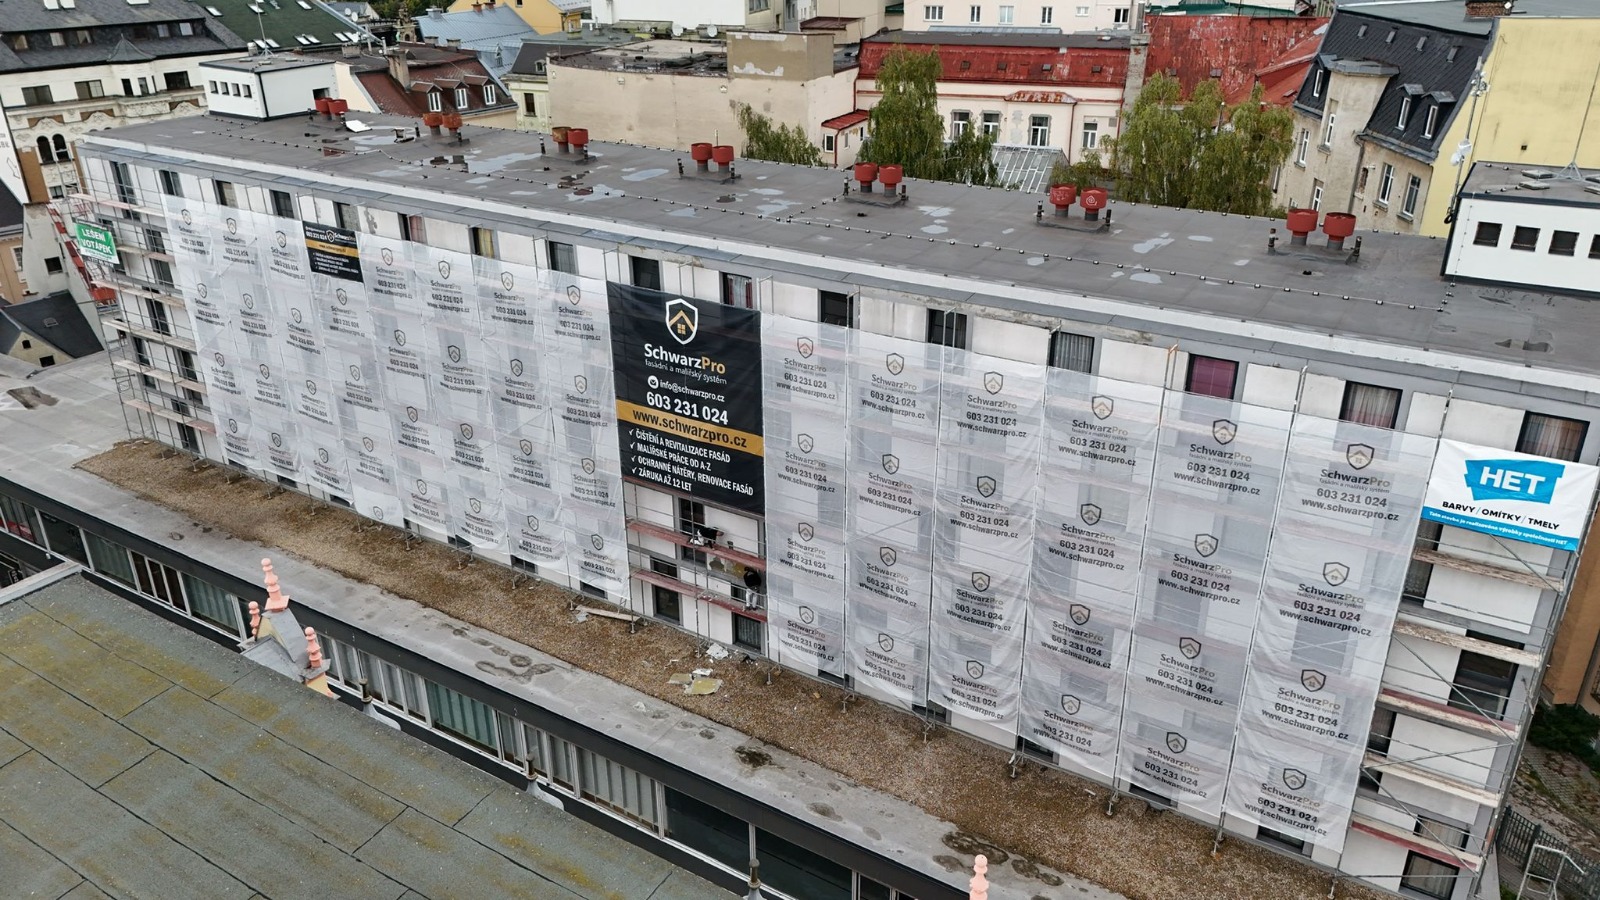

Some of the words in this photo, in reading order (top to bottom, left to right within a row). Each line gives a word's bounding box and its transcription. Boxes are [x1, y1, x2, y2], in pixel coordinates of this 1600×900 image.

[644, 343, 725, 374] SchwarzPro
[784, 358, 826, 372] SchwarzPro
[645, 359, 668, 372] fasádní
[675, 367, 702, 380] malířský
[703, 374, 727, 384] systém
[784, 373, 797, 382] 603
[798, 376, 811, 385] 231
[813, 379, 826, 389] 024
[660, 379, 725, 402] info@schwarzpro.cz
[776, 382, 835, 399] www.schwarzpro.cz
[872, 374, 917, 390] SchwarzPro
[646, 391, 671, 410] 603
[674, 399, 699, 418] 231
[702, 405, 728, 425] 024
[871, 391, 884, 400] 603
[886, 394, 899, 403] 231
[901, 397, 916, 407] 024
[968, 395, 1017, 409] SchwarzPro
[862, 400, 925, 419] www.schwarzpro.cz
[967, 412, 981, 421] 603
[983, 414, 998, 423] 231
[1001, 417, 1016, 426] 024
[633, 410, 747, 448] www.schwarzpro.cz
[957, 421, 1026, 437] www.schwarzpro.cz
[1072, 420, 1128, 436] SchwarzPro
[636, 428, 659, 443] ČIŠTĚNÍ
[660, 437, 664, 446] A
[665, 438, 708, 458] REVITALIZACE
[709, 451, 731, 463] FASÁD
[1070, 437, 1087, 446] 603
[1089, 440, 1105, 450] 231
[1109, 443, 1126, 453] 024
[1190, 444, 1252, 462] SchwarzPro
[637, 442, 668, 459] MALÍŘSKÉ
[669, 452, 689, 466] PRÁCE
[690, 458, 699, 468] OD
[700, 460, 711, 472] A-Z
[1059, 445, 1136, 466] www.schwarzpro.cz
[638, 456, 671, 473] OCHRANNÉ
[698, 472, 731, 490] RENOVACE
[732, 483, 753, 496] FASÁD
[639, 467, 663, 482] ZÁRUKA
[664, 474, 672, 485] AŽ
[673, 478, 681, 488] 12
[682, 480, 692, 491] LET
[785, 466, 797, 475] 603
[799, 469, 811, 478] 231
[813, 472, 826, 482] 024
[869, 472, 912, 489] SchwarzPro
[1187, 462, 1205, 473] 603
[1208, 466, 1226, 477] 231
[1230, 469, 1250, 481] 024
[1320, 469, 1391, 488] SchwarzPro
[1479, 466, 1546, 495] HET
[1174, 472, 1260, 495] www.schwarzpro.cz
[859, 495, 921, 516] www.schwarzpro.cz
[868, 487, 880, 497] 603
[882, 491, 895, 501] 231
[898, 495, 912, 505] 024
[961, 496, 1009, 512] SchwarzPro
[1317, 488, 1337, 500] 603
[1340, 491, 1361, 504] 231
[1365, 495, 1387, 508] 024
[960, 511, 974, 520] 603
[976, 514, 991, 523] 231
[993, 517, 1009, 527] 024
[1301, 499, 1399, 521] www.schwarzpro.cz
[1442, 501, 1475, 513] BARVY
[1482, 509, 1521, 522] OMÍTKY
[1528, 518, 1559, 531] TMELY
[950, 519, 1018, 538] www.schwarzpro.cz
[1062, 524, 1115, 541] SchwarzPro
[1049, 547, 1124, 570] www.schwarzpro.cz
[1060, 540, 1076, 550] 603
[1078, 543, 1094, 554] 231
[1097, 547, 1114, 558] 024
[866, 563, 908, 581] SchwarzPro
[1174, 554, 1232, 574] SchwarzPro
[1158, 578, 1240, 604] www.schwarzpro.cz
[1171, 570, 1188, 581] 603
[1191, 575, 1208, 586] 231
[1211, 580, 1230, 592] 024
[957, 589, 1003, 605] SchwarzPro
[1298, 583, 1364, 603] SchwarzPro
[955, 603, 969, 613] 603
[987, 611, 1003, 621] 024
[1294, 600, 1313, 613] 603
[1316, 605, 1336, 617] 231
[1340, 609, 1361, 622] 024
[788, 620, 825, 638] SchwarzPro
[1053, 621, 1103, 641] SchwarzPro
[1279, 608, 1372, 636] www.schwarzpro.cz
[1041, 641, 1111, 669] www.schwarzpro.cz
[1068, 640, 1083, 651] 231
[1086, 645, 1102, 656] 024
[1161, 654, 1215, 677] SchwarzPro
[952, 675, 997, 694] SchwarzPro
[1146, 676, 1223, 706] www.schwarzpro.cz
[1158, 669, 1174, 681] 603
[1176, 675, 1192, 687] 231
[1195, 681, 1213, 693] 024
[982, 697, 997, 708] 024
[1278, 688, 1341, 710] SchwarzPro
[1262, 709, 1349, 739] www.schwarzpro.cz
[1275, 703, 1293, 716] 603
[1296, 708, 1314, 721] 231
[1318, 714, 1338, 727] 024
[1148, 748, 1200, 771] SchwarzPro
[1145, 762, 1160, 775] 603
[1162, 767, 1178, 781] 231
[1181, 773, 1198, 787] 024
[1261, 783, 1320, 807] SchwarzPro
[1245, 803, 1327, 836] www.schwarzpro.cz
[1258, 797, 1275, 810] 603
[1277, 803, 1295, 816] 231
[1298, 809, 1318, 823] 024
